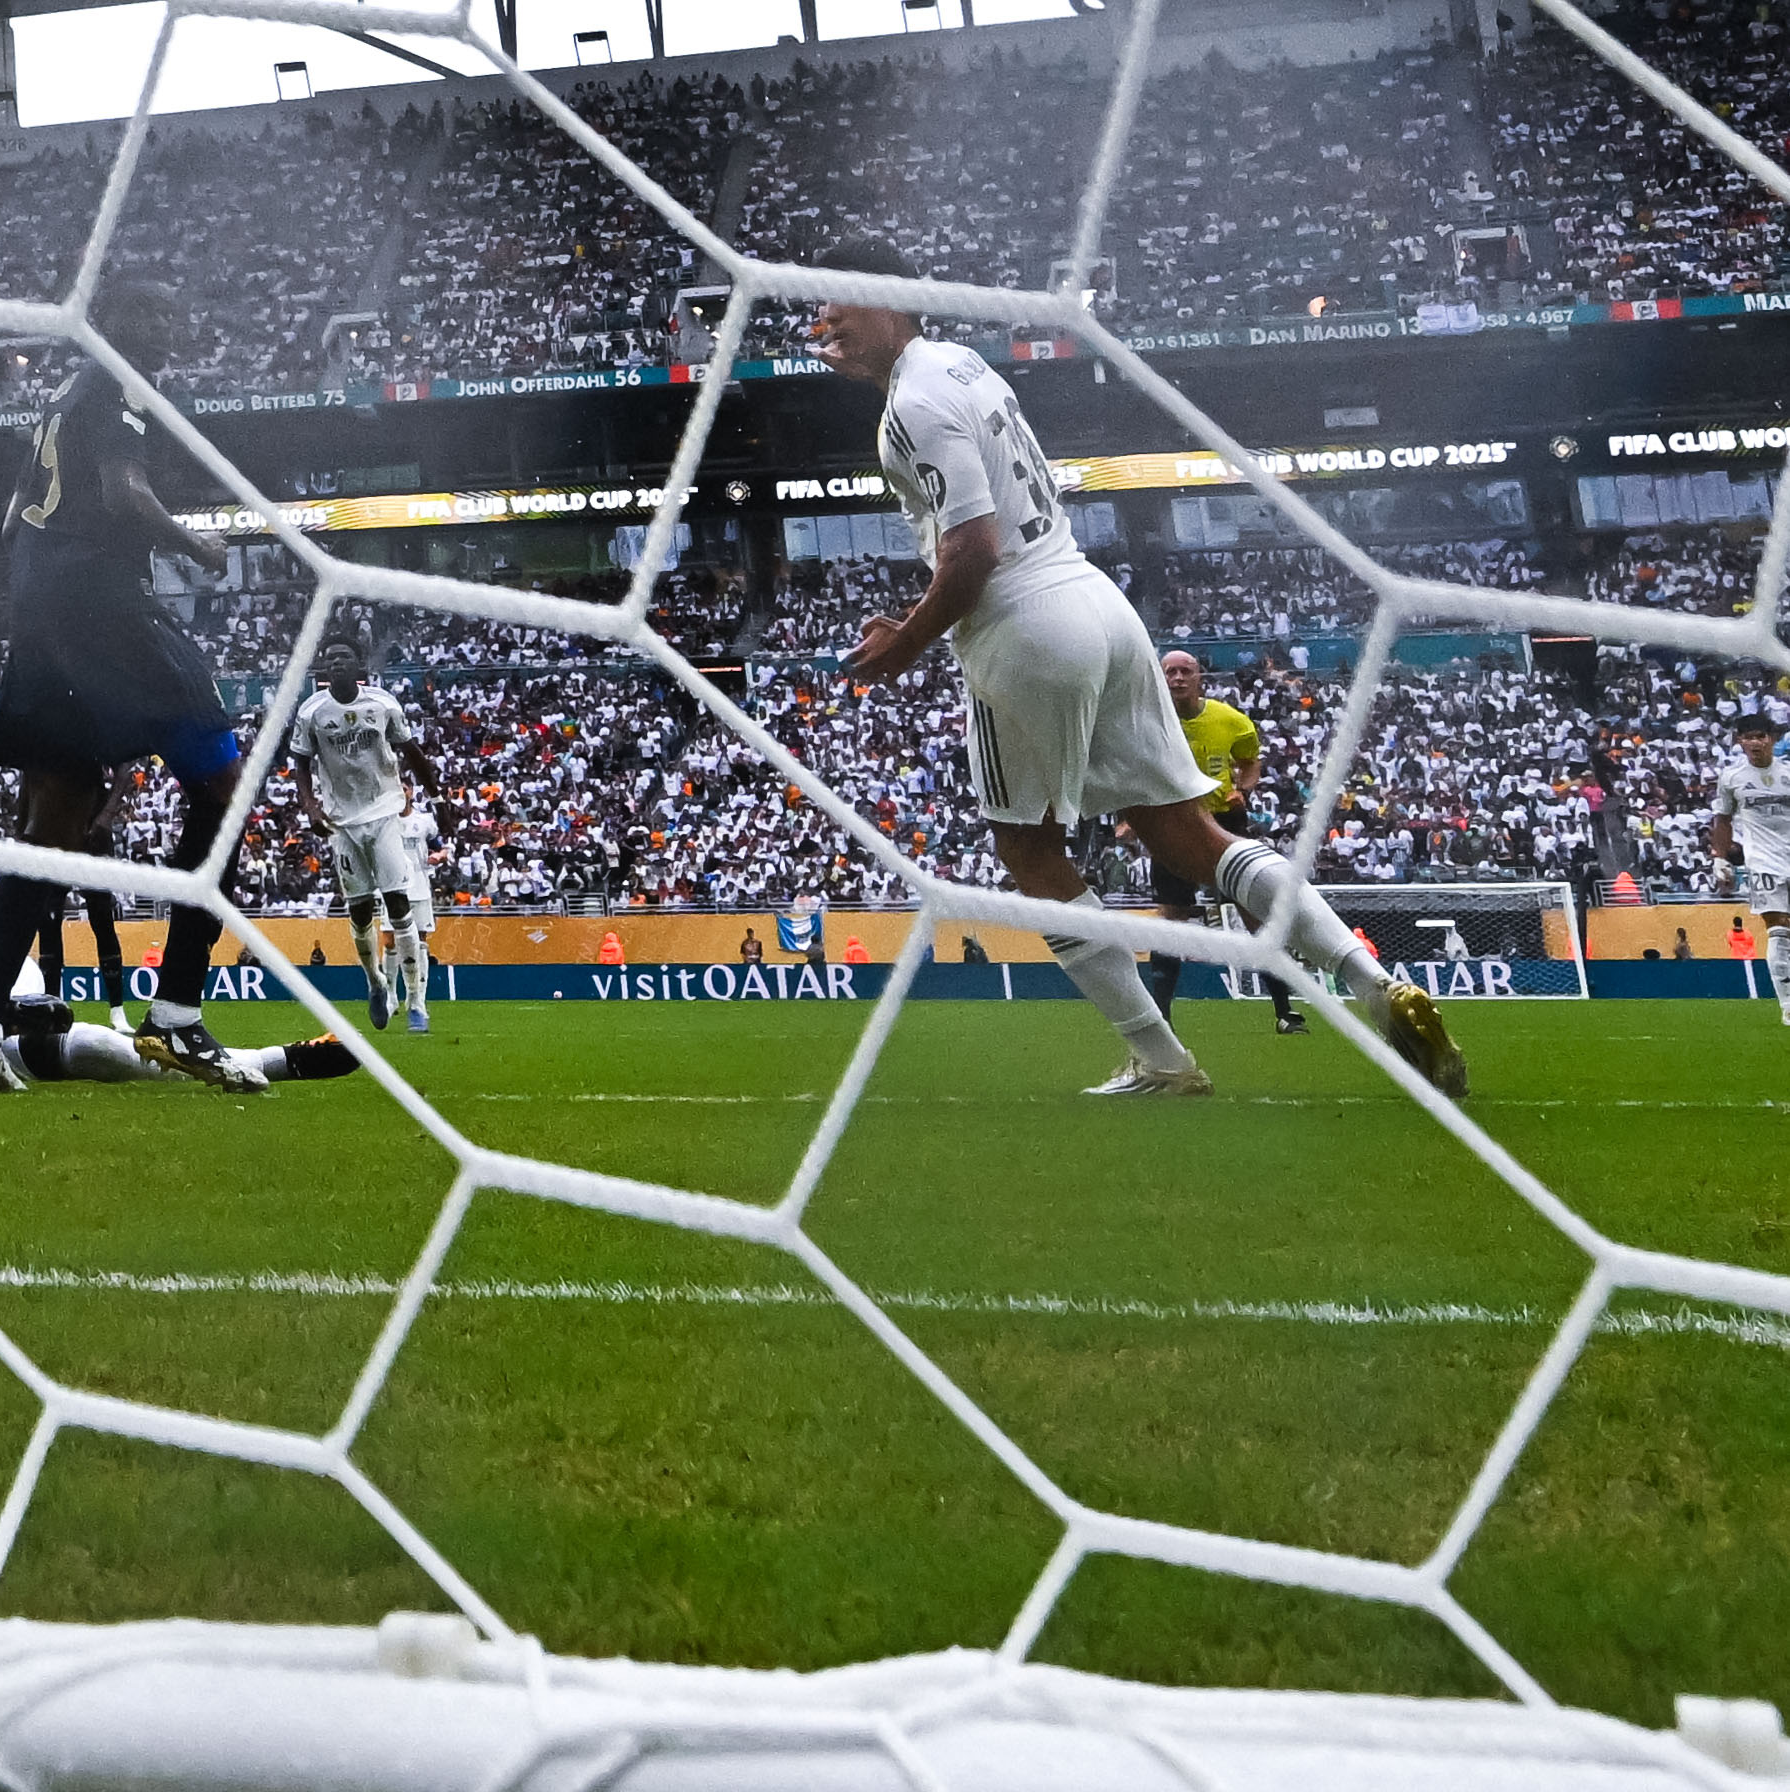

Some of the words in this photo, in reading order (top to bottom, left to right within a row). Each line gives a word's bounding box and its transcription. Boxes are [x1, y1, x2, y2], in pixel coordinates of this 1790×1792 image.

[1249, 327, 1297, 346] DAN
[1302, 321, 1391, 343] MARINO
[455, 379, 505, 398] JOHN
[510, 373, 609, 394] OFFERDAHL
[614, 369, 642, 387] 56
[194, 397, 244, 415] DOUG
[322, 389, 347, 407] 75
[1607, 432, 1667, 457] FIFA
[1668, 428, 1737, 454] CLUB
[1741, 426, 1790, 449] WO
[1174, 458, 1224, 479] FIFA
[1295, 448, 1387, 474] WORLD
[1389, 445, 1439, 470] CUP
[1443, 442, 1509, 466] 2025
[775, 478, 825, 501] FIFA
[826, 476, 886, 497] CLUB
[407, 500, 452, 519] FIFA
[454, 497, 508, 517] CLUB
[510, 493, 588, 514] WORLD
[589, 489, 633, 509] CUP
[635, 487, 690, 507] 205
[172, 511, 232, 532] ORLD
